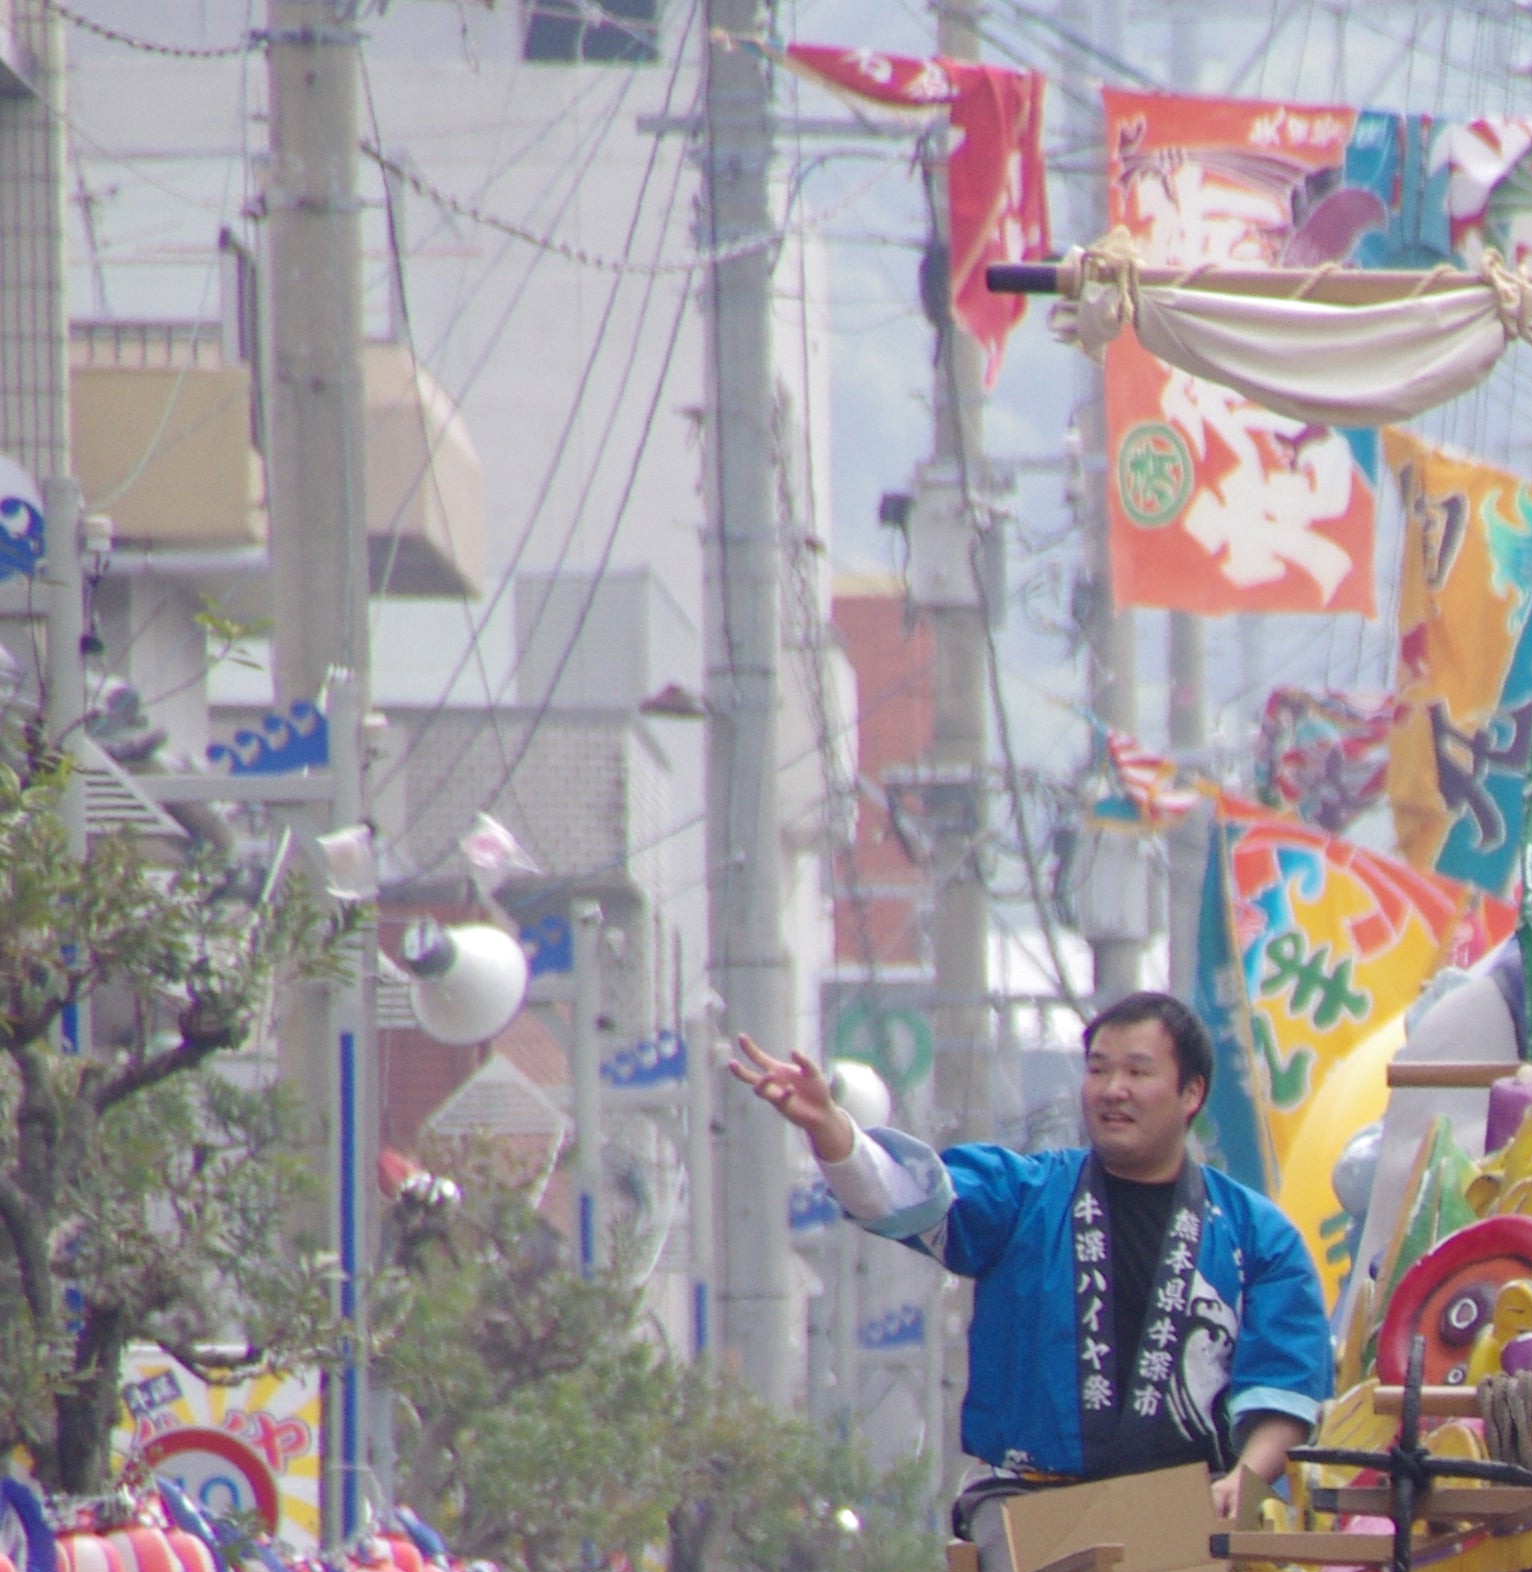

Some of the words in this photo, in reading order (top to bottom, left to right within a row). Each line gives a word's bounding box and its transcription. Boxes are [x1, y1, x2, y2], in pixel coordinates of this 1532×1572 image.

[1133, 1207, 1201, 1417] 熊本県牛深市
